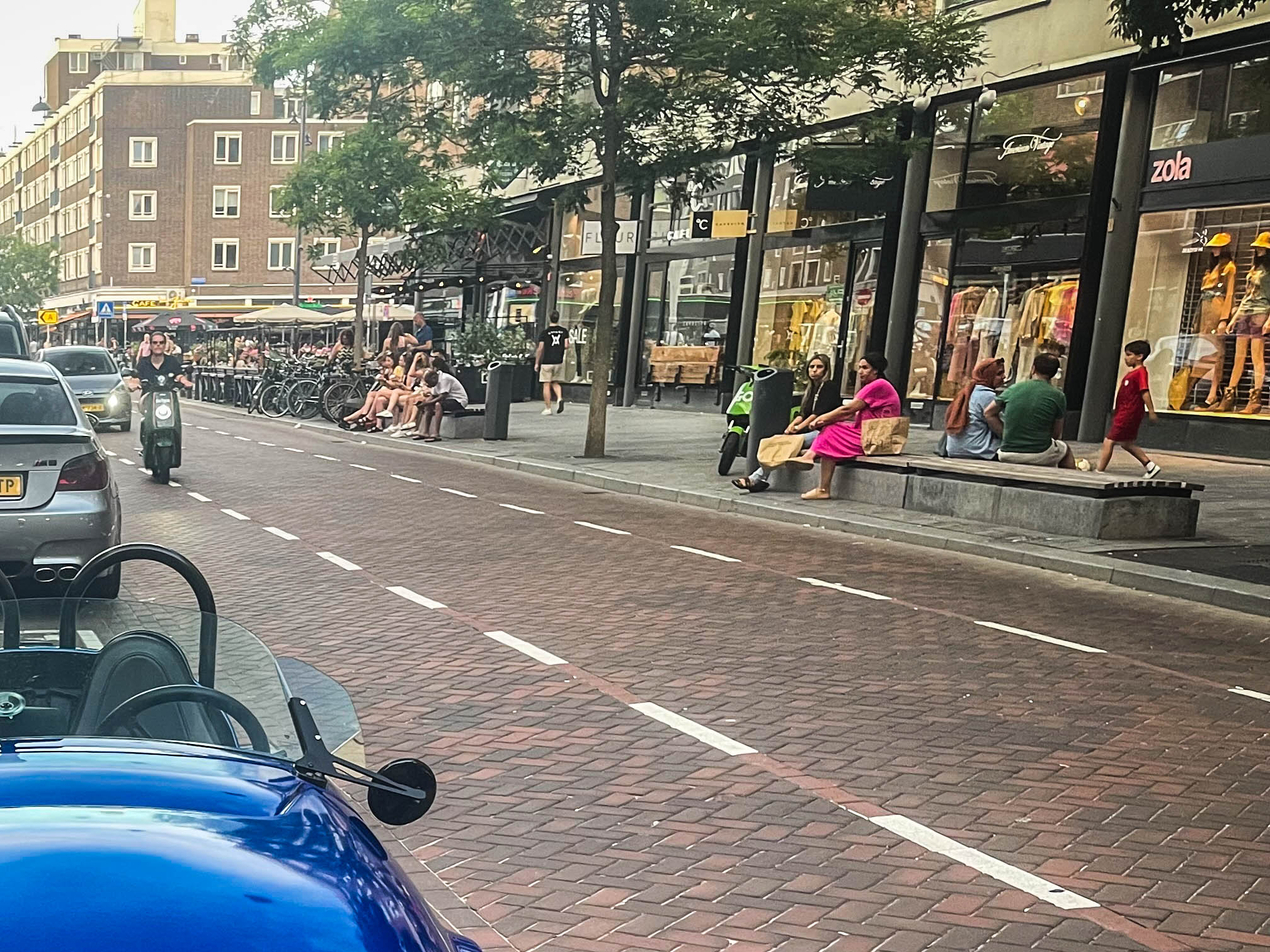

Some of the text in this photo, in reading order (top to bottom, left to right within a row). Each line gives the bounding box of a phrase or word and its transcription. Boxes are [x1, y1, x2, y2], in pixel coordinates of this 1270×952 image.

[1150, 150, 1192, 183] zola
[585, 231, 635, 244] FLUR
[569, 327, 588, 344] SALE
